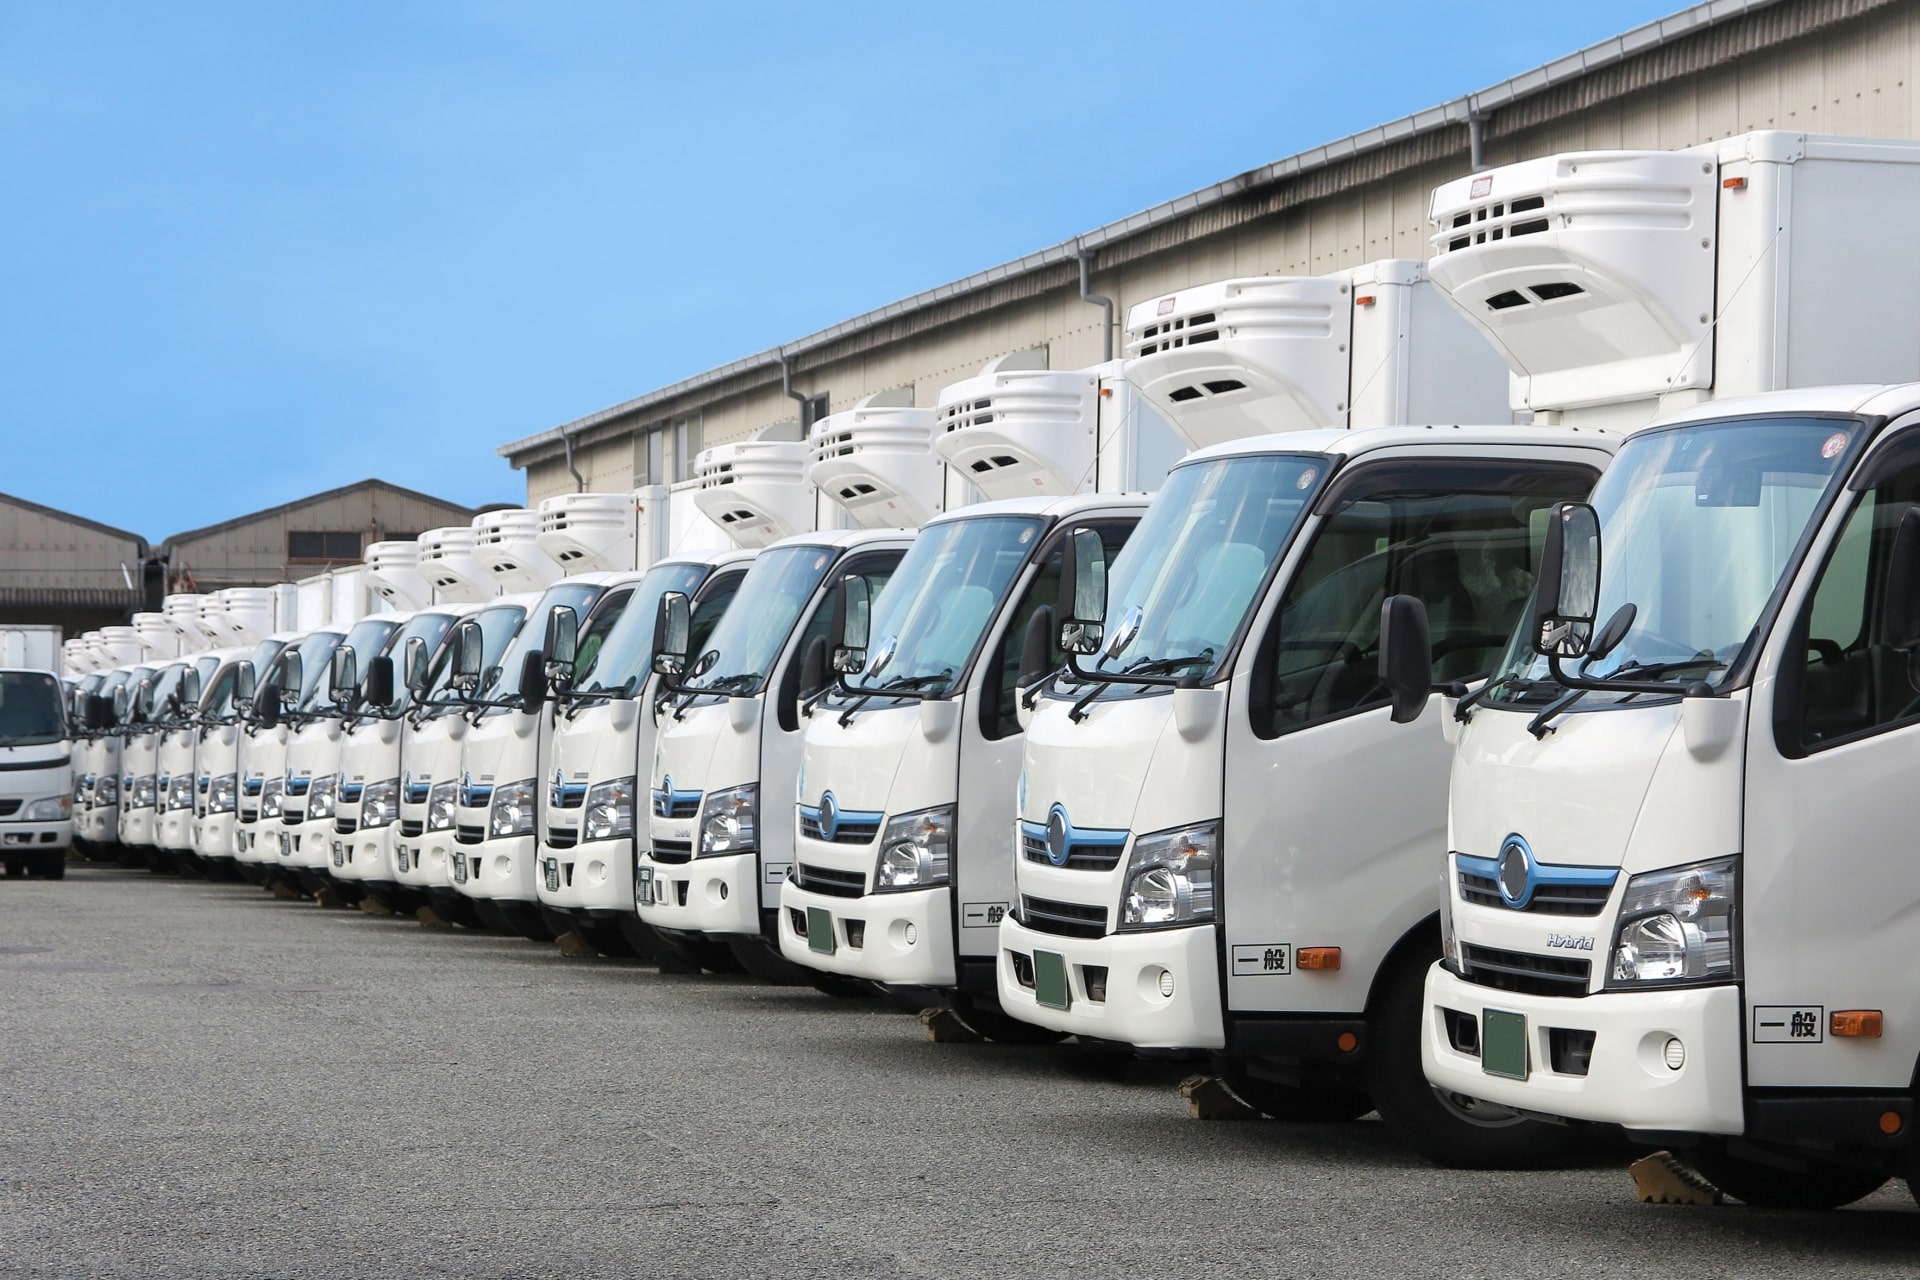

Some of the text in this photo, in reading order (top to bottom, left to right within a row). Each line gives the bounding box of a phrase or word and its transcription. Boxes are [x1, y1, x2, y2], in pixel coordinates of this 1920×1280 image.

[967, 905, 1004, 923] 一般
[1546, 933, 1595, 951] Hybrid
[1237, 948, 1285, 971] 一般
[1759, 1010, 1817, 1038] 一般
